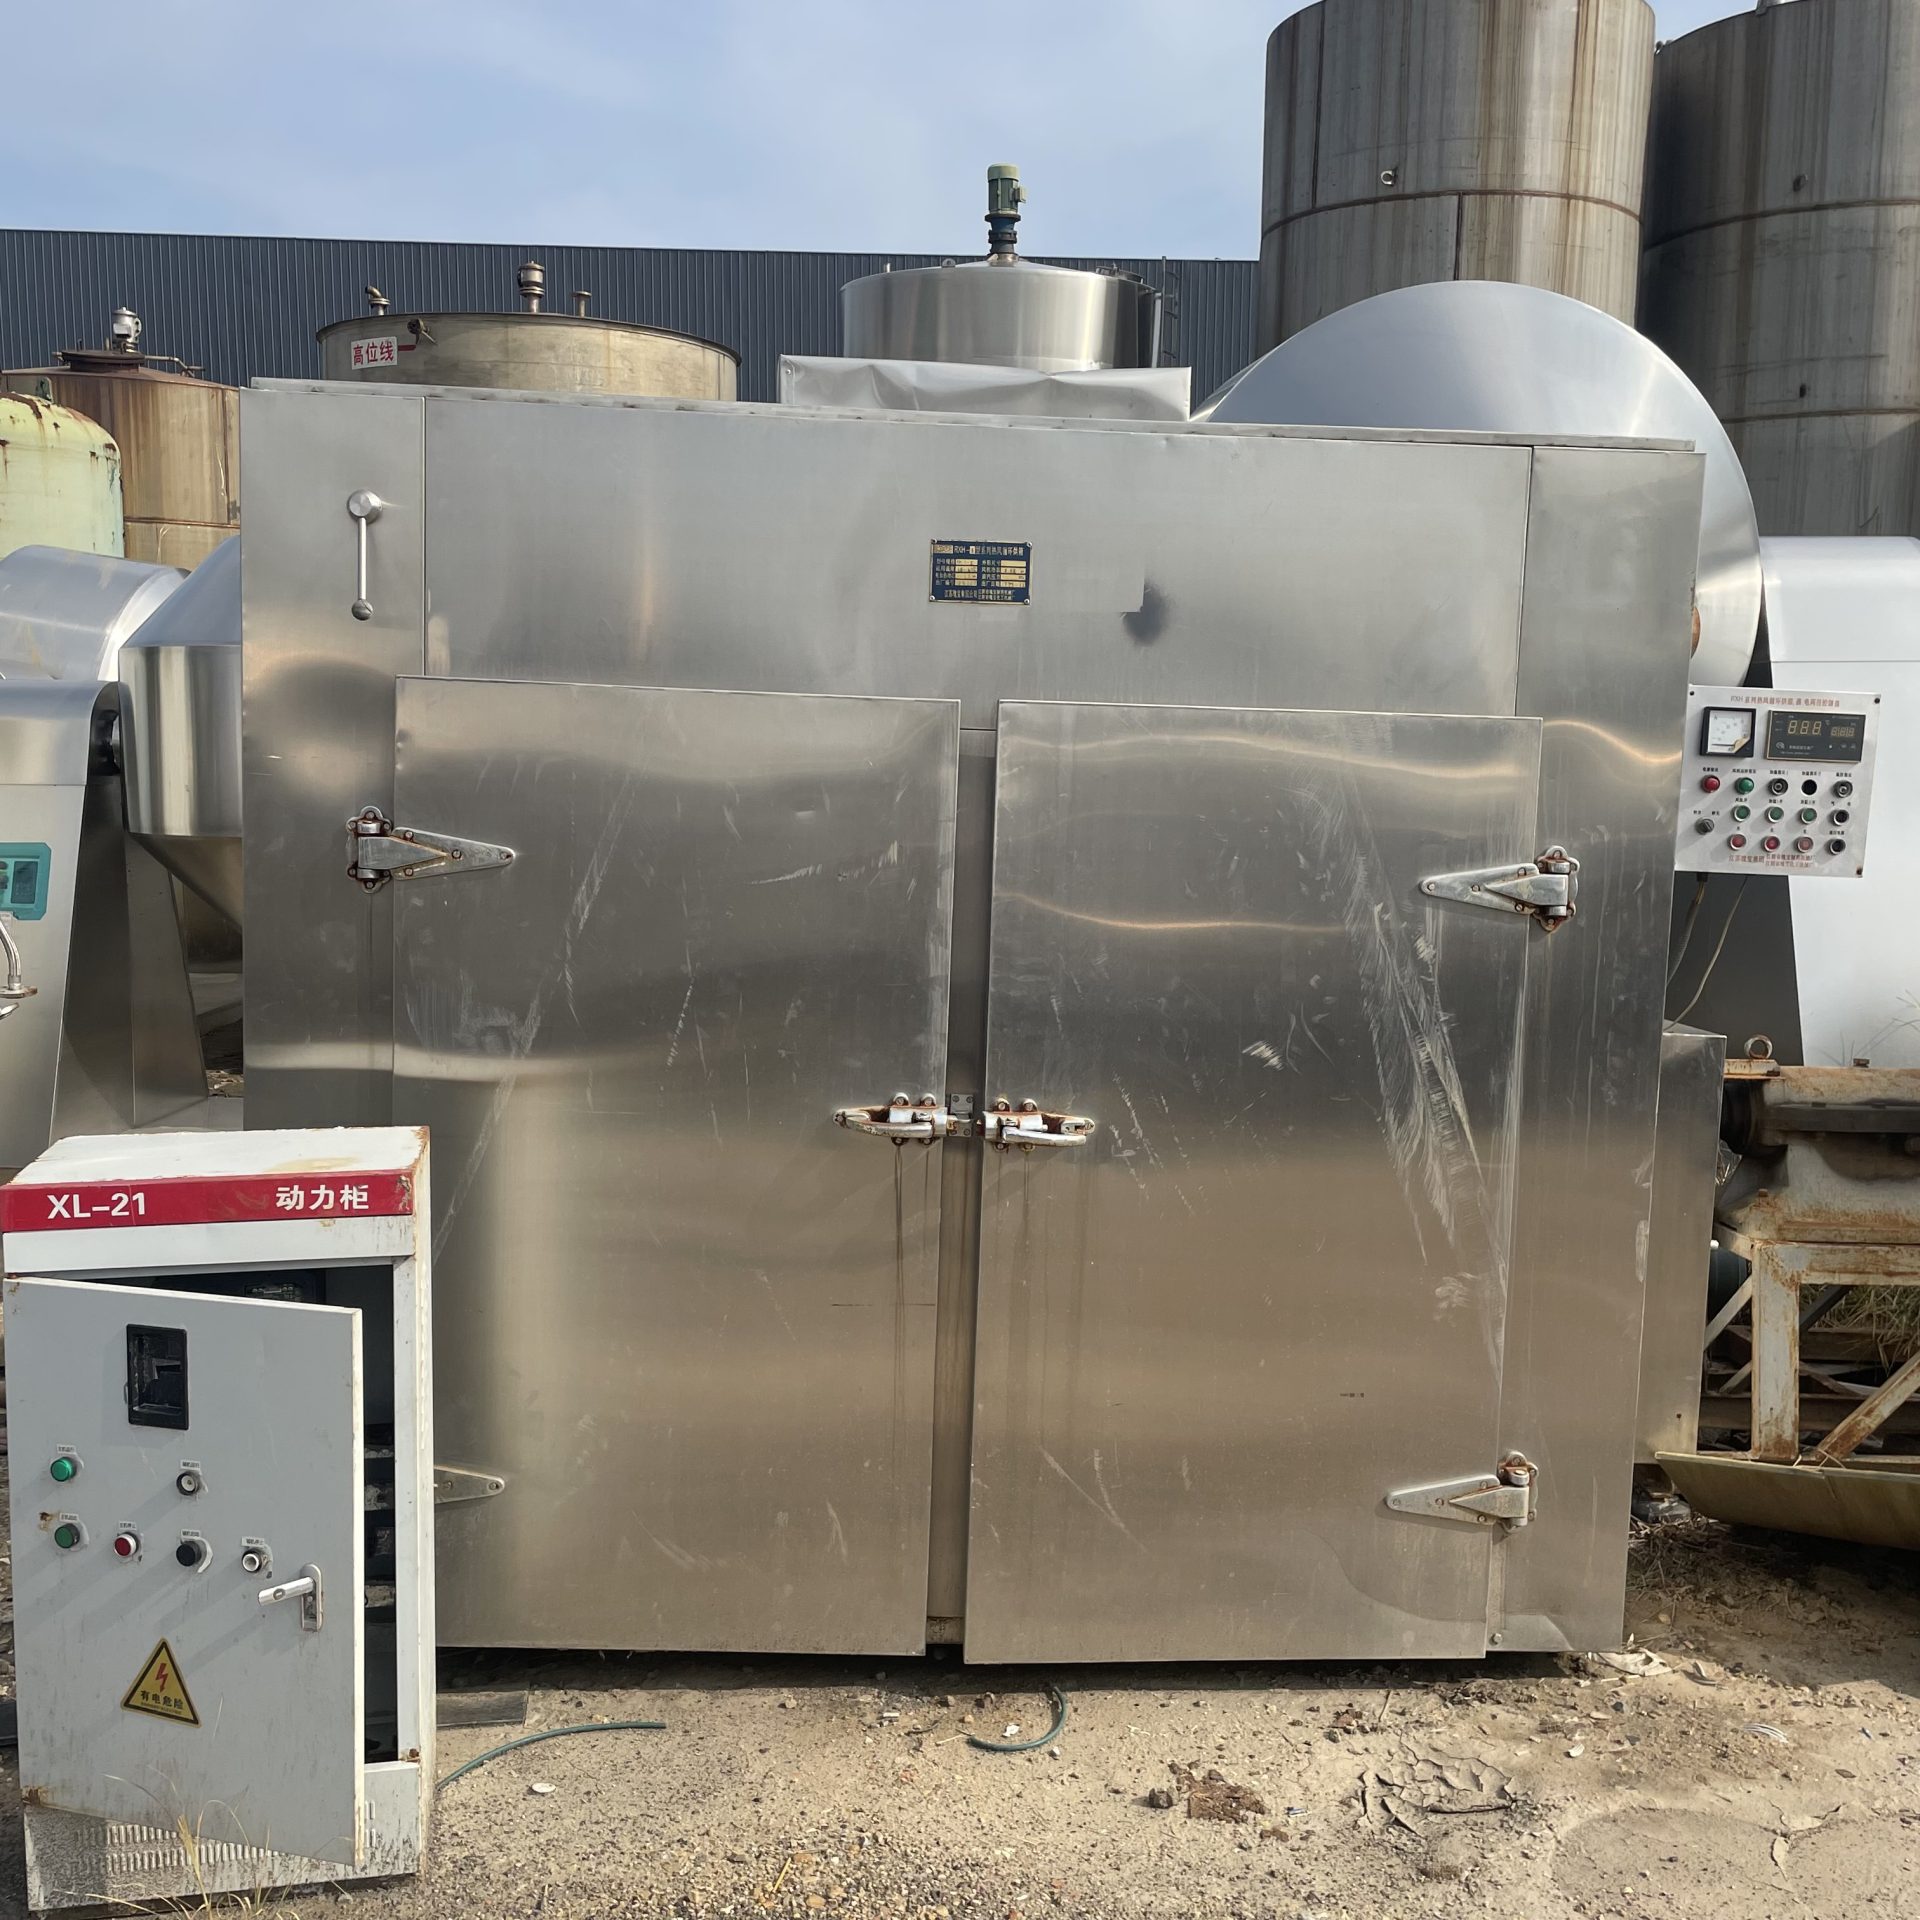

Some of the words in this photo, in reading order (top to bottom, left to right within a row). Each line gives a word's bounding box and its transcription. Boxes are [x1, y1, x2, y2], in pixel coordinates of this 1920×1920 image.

[354, 341, 393, 365] 高位线
[47, 1192, 146, 1220] XL-21
[275, 1184, 369, 1211] 动力柜
[141, 1690, 183, 1709] 有电危险
